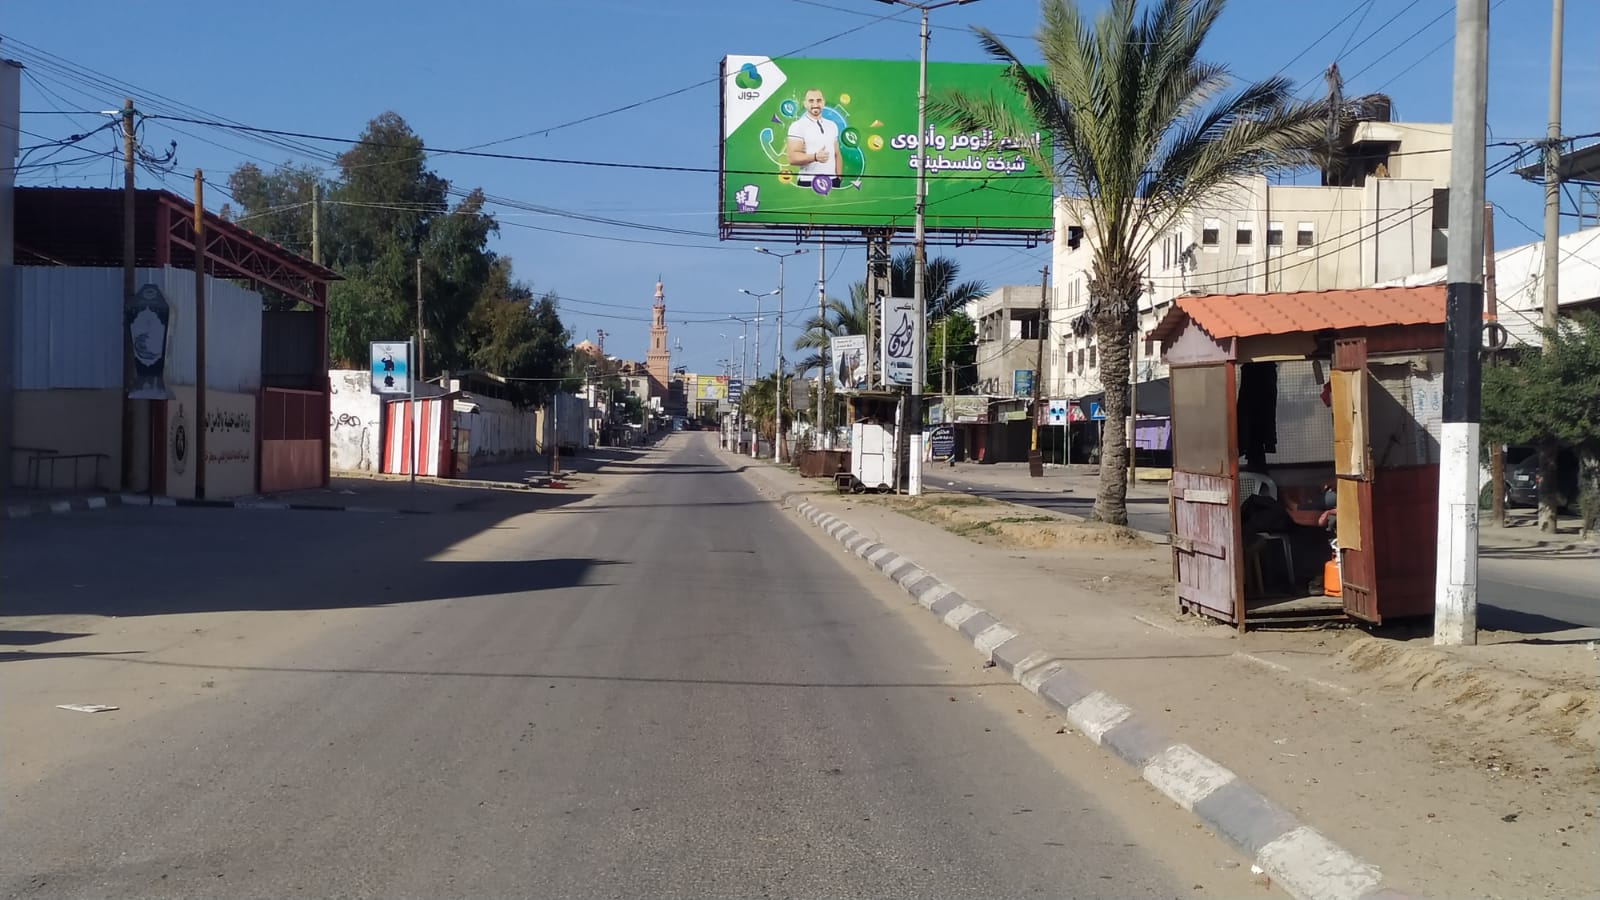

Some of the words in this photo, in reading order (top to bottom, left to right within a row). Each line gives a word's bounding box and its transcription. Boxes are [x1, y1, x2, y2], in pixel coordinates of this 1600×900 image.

[738, 91, 760, 101] جوال
[909, 154, 982, 174] فلسطينة
[986, 155, 1026, 174] شبكة
[894, 302, 915, 312] اكسي
